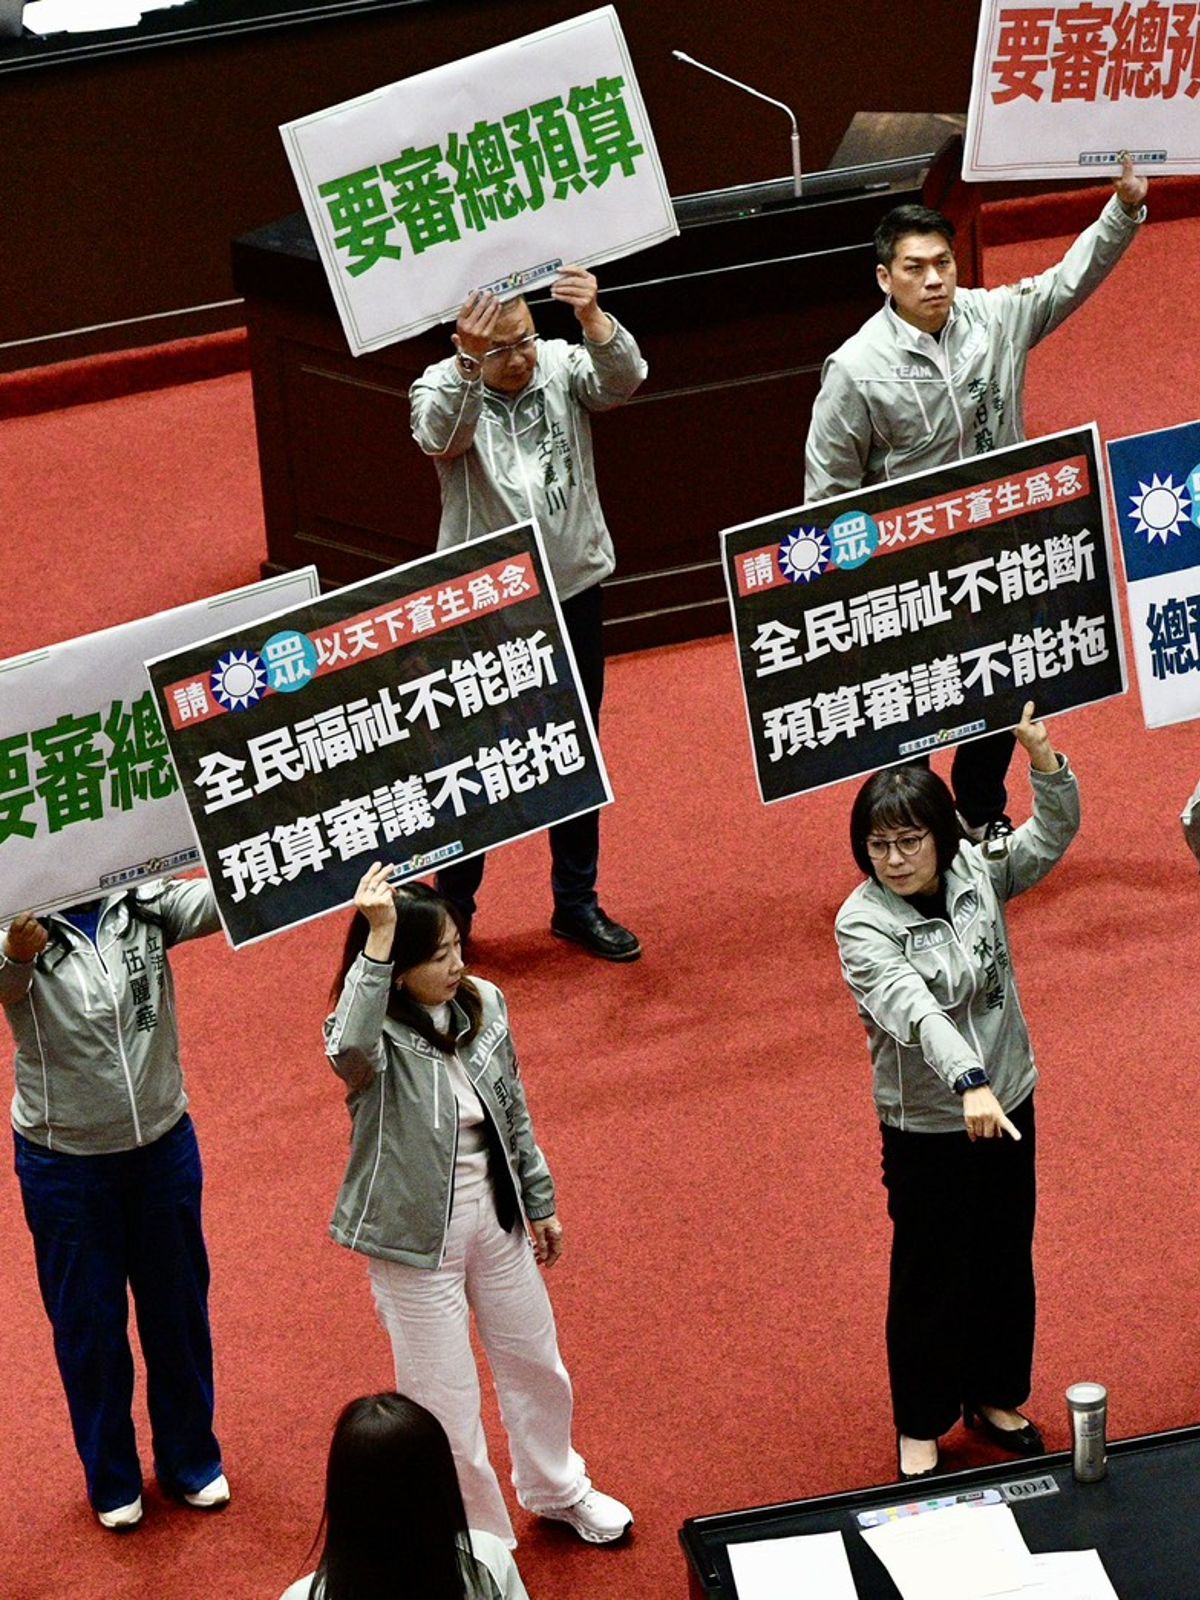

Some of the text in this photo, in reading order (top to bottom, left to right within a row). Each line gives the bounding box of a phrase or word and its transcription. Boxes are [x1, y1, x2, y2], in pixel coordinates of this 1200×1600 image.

[318, 75, 644, 278] 要審總預算
[750, 529, 1096, 678] 全民福祉不能斷
[194, 629, 559, 815] 全民福祉不能斷
[762, 615, 1109, 763] 預算審議不能拖
[218, 720, 586, 904] 預算審議不能拖
[121, 946, 158, 1032] 伍麗華
[1009, 1480, 1050, 1496] 004
